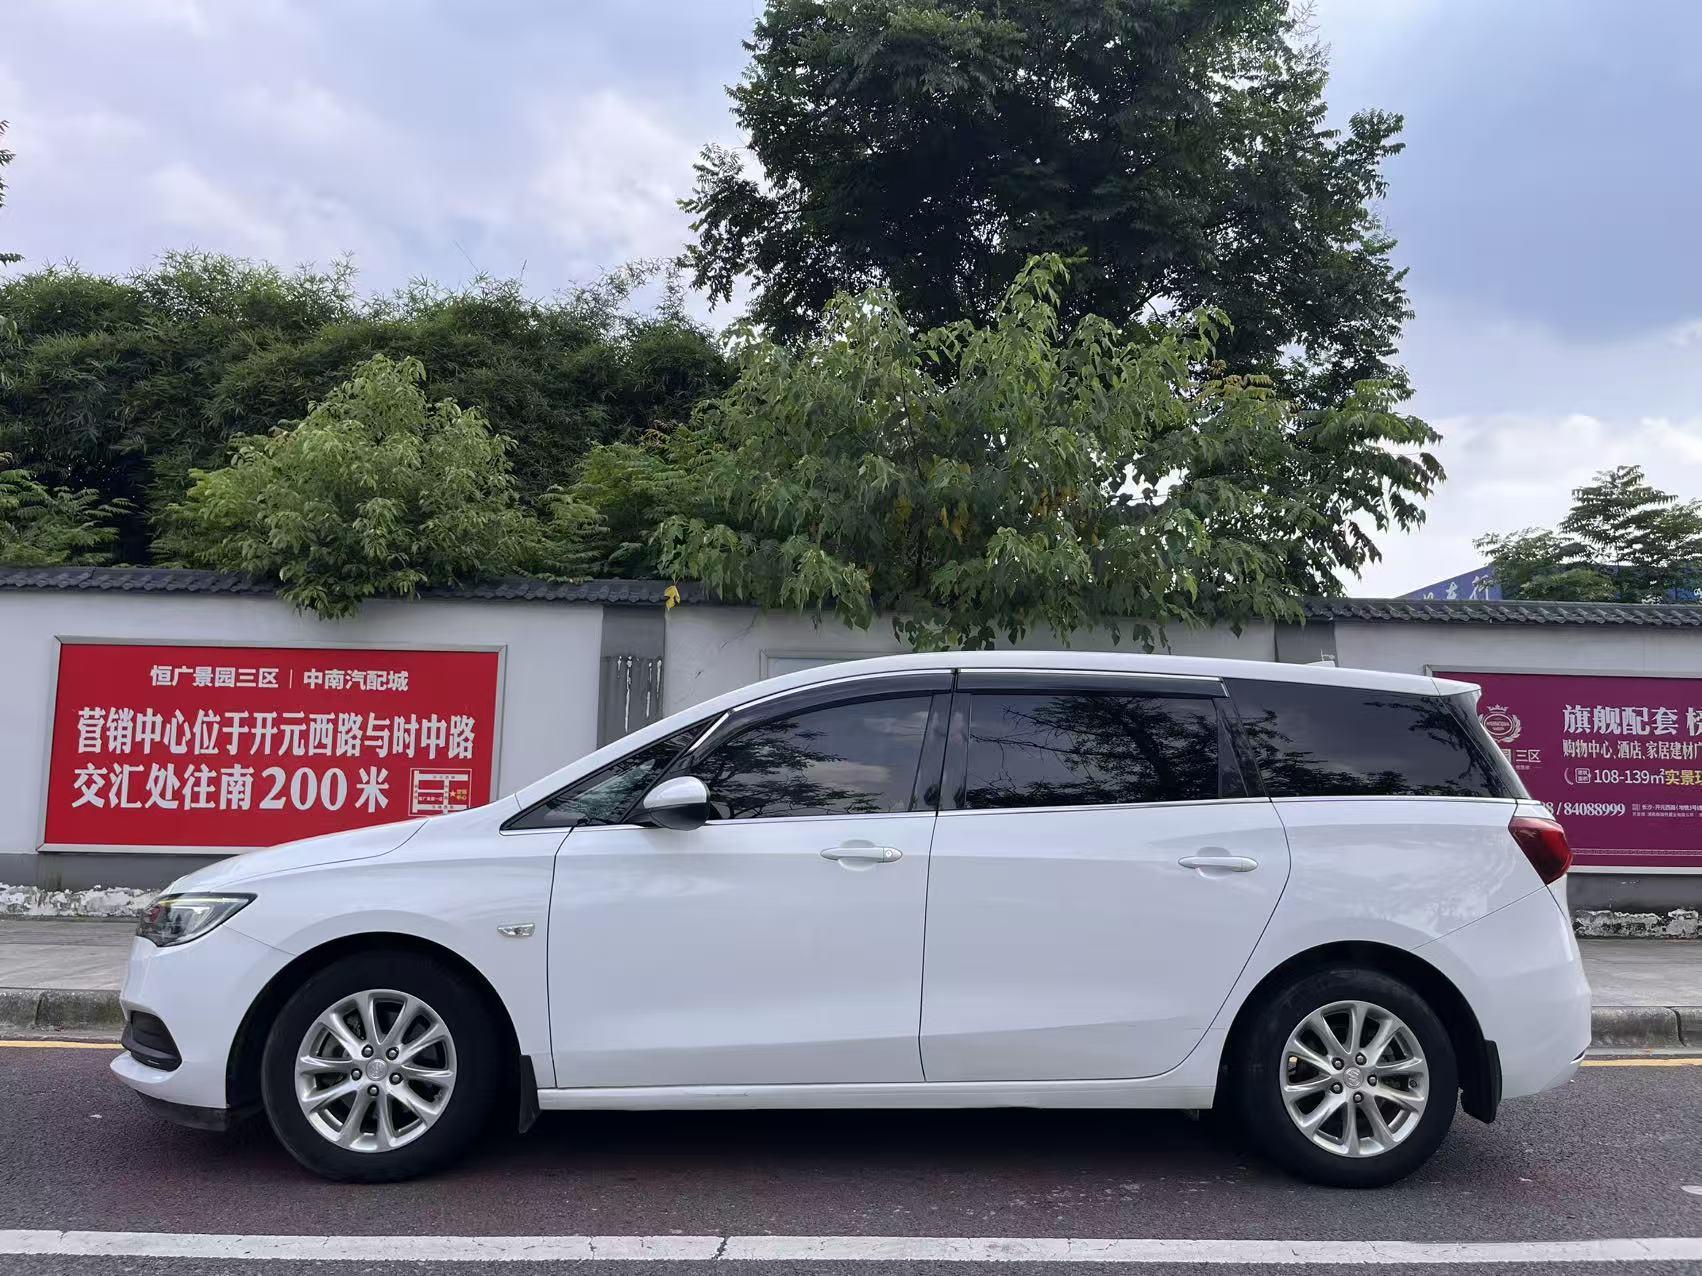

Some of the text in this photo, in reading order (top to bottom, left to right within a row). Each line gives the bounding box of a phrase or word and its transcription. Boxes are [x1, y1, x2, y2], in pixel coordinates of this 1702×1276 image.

[150, 664, 409, 692] 恒广景园三区 中南汽配城
[77, 706, 476, 760] 营销中心位于开元西路与时中路
[1562, 704, 1679, 735] 旗舰配套
[71, 762, 390, 813] 交汇处往南200米
